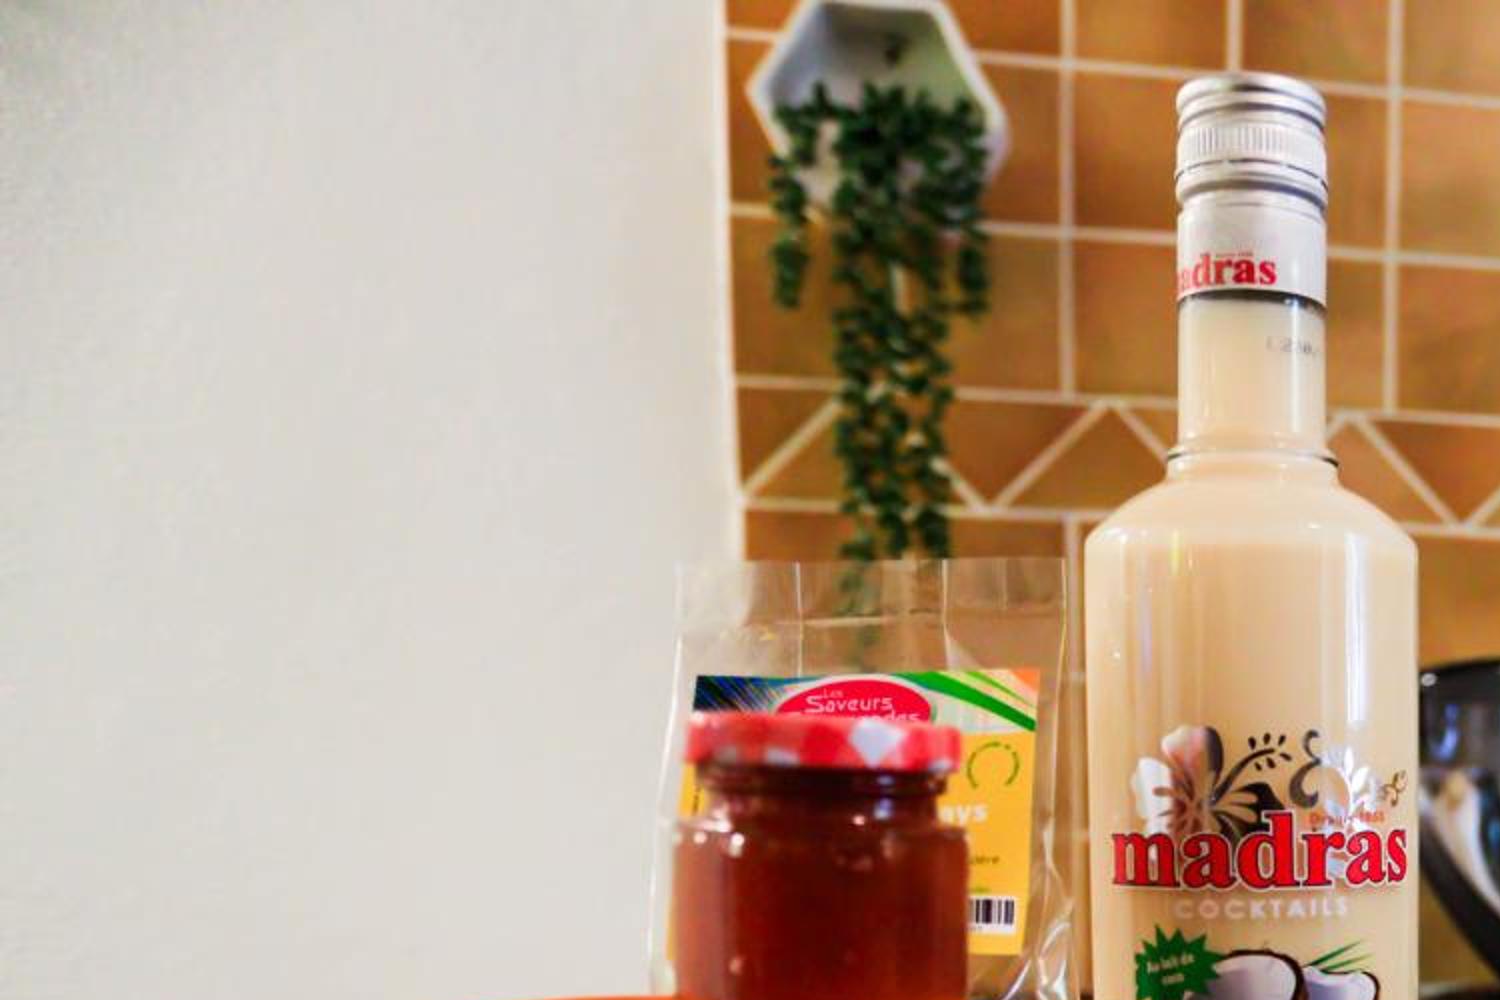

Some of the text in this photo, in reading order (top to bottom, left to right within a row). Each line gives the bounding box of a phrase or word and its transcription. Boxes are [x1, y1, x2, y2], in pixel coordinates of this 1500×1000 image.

[803, 695, 894, 713] Saveurs
[1112, 810, 1408, 889] madras
[1174, 896, 1348, 921] COCKTAILS
